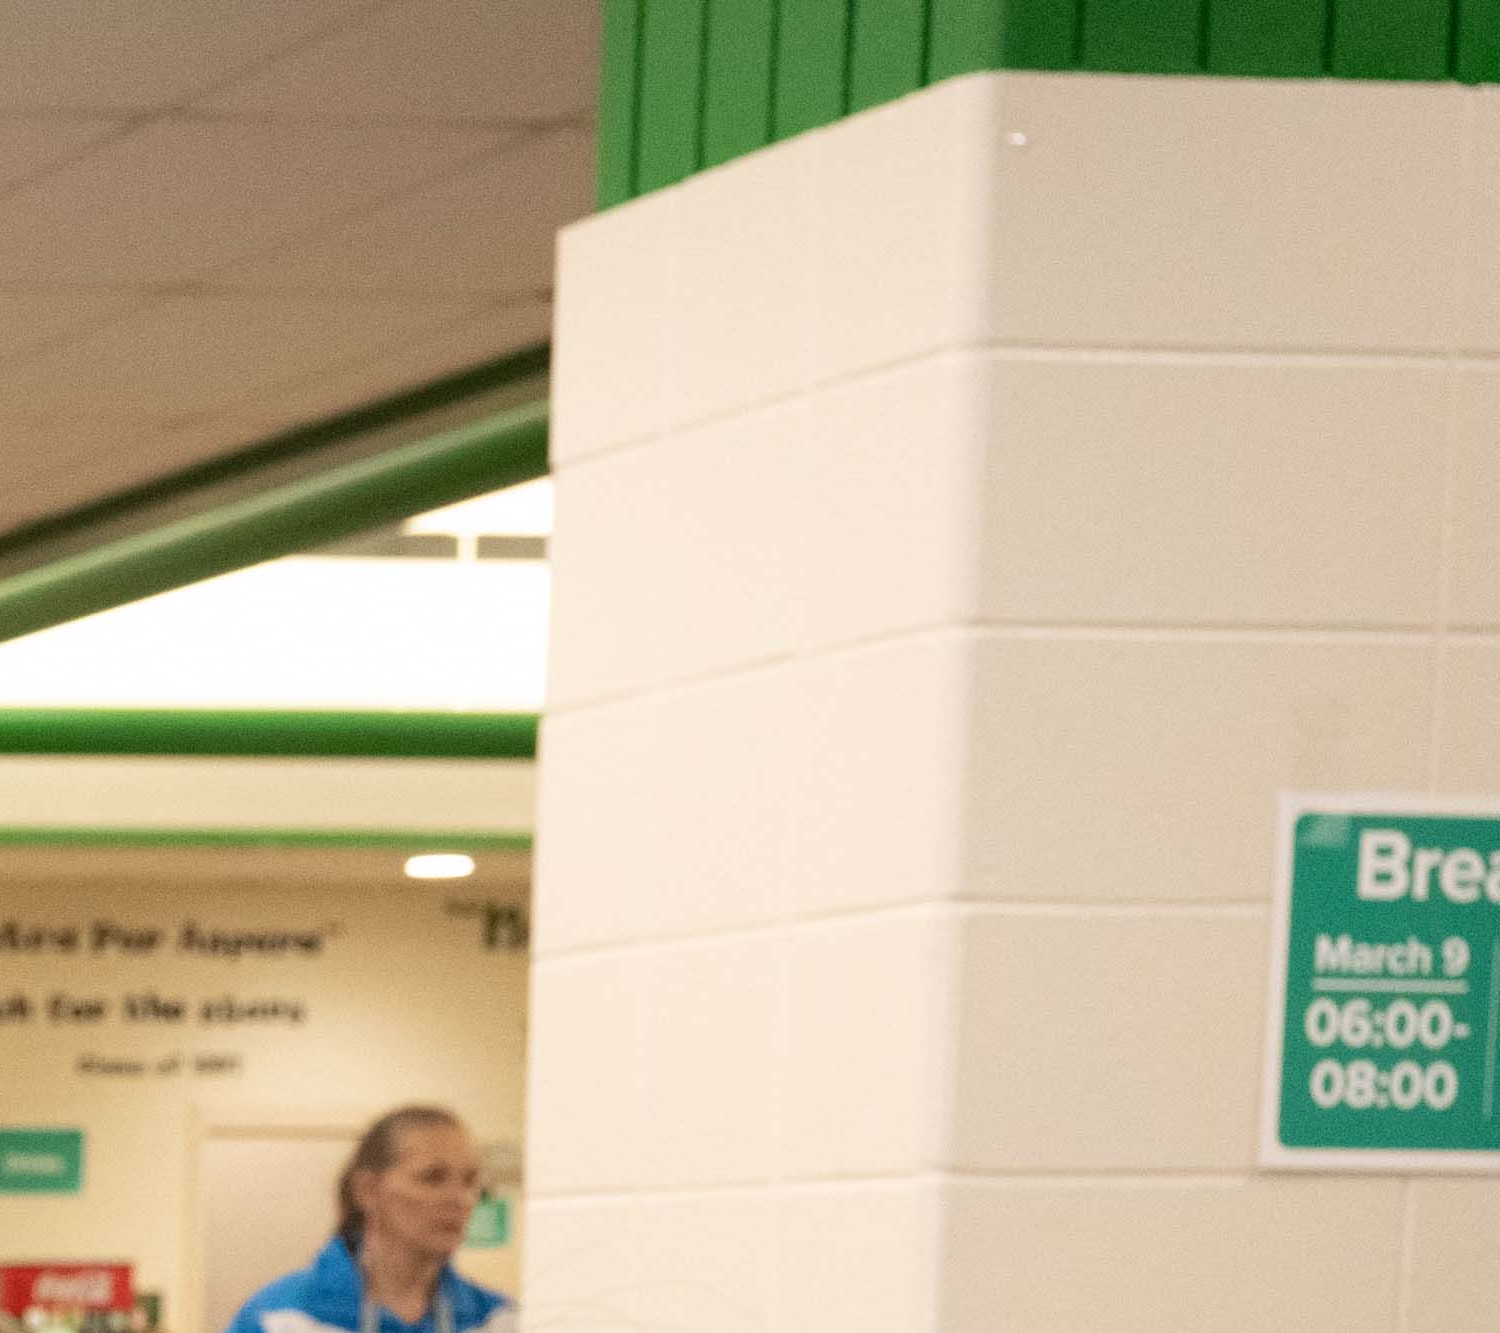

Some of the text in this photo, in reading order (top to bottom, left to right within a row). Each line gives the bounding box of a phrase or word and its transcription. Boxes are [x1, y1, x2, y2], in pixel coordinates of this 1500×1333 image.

[1313, 934, 1470, 977] March 9
[1304, 999, 1470, 1048] 06:00-
[1309, 1060, 1458, 1110] 08:00
